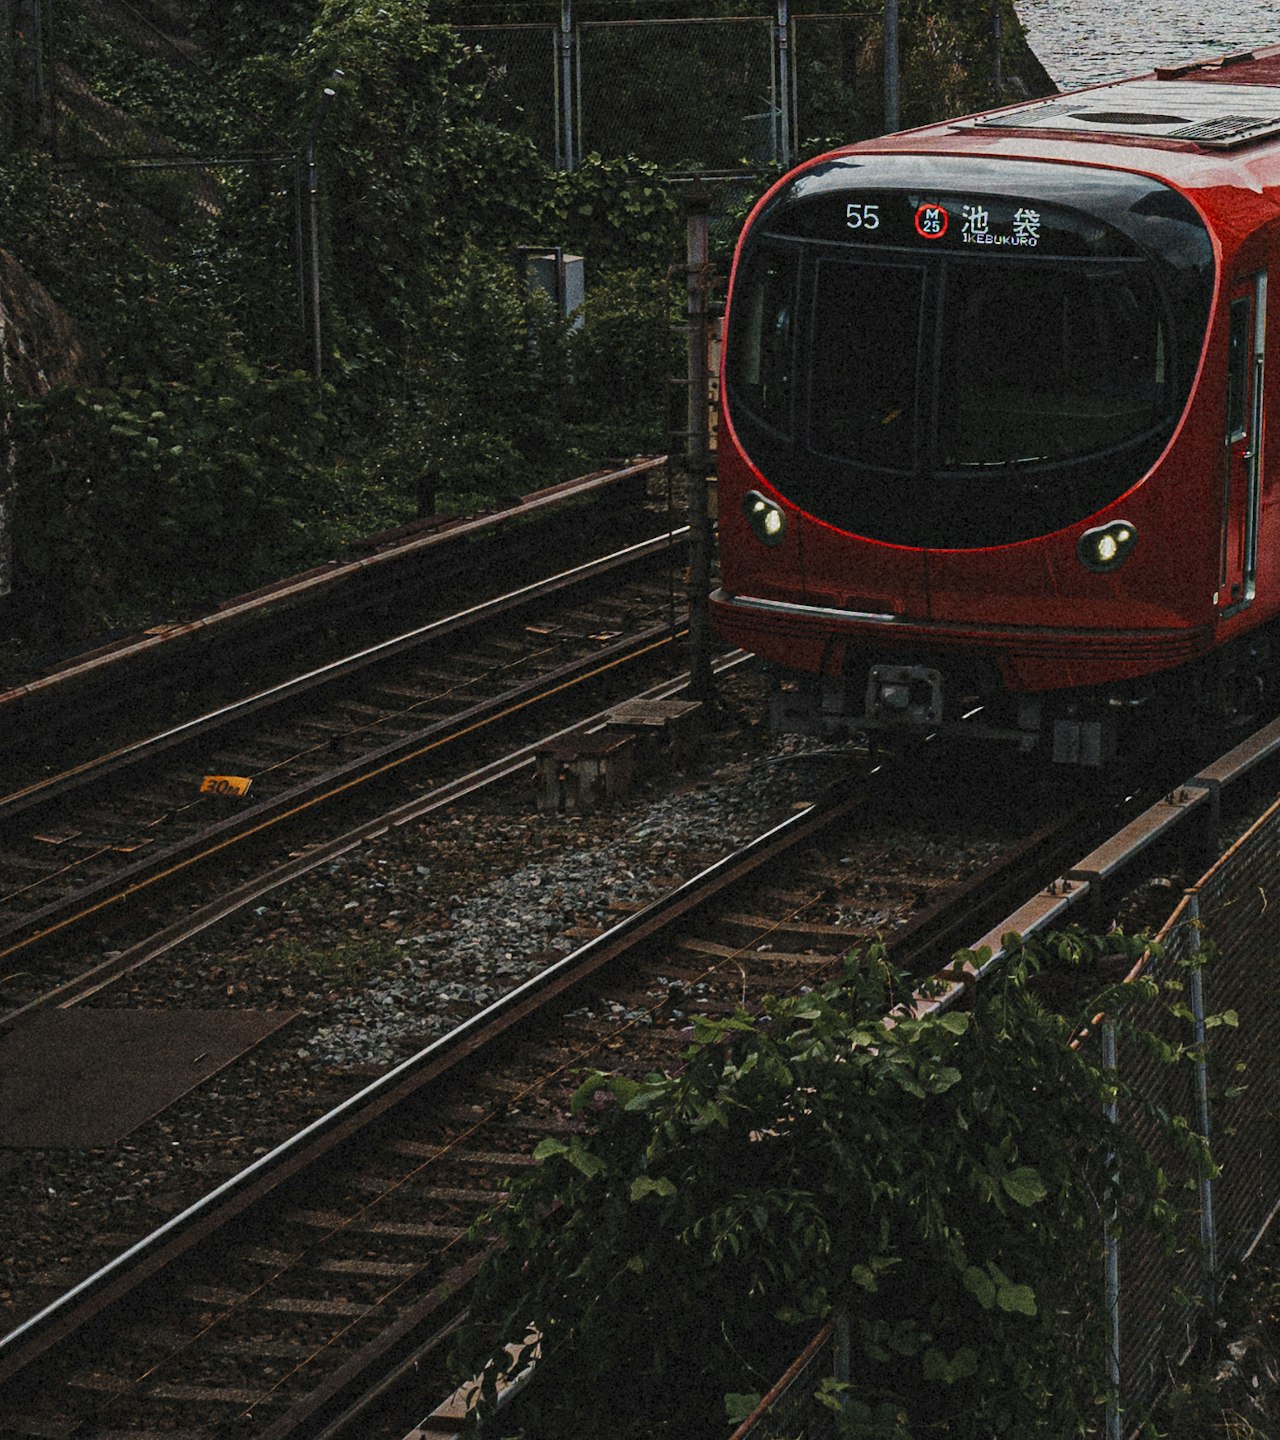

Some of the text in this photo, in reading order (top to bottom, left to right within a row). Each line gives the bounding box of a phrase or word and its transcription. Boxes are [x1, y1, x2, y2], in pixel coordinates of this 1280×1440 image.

[846, 203, 880, 230] 55
[925, 209, 939, 220] M
[961, 204, 1041, 238] 池袋
[922, 219, 941, 233] 25
[962, 232, 1038, 247] IKEBUKURO
